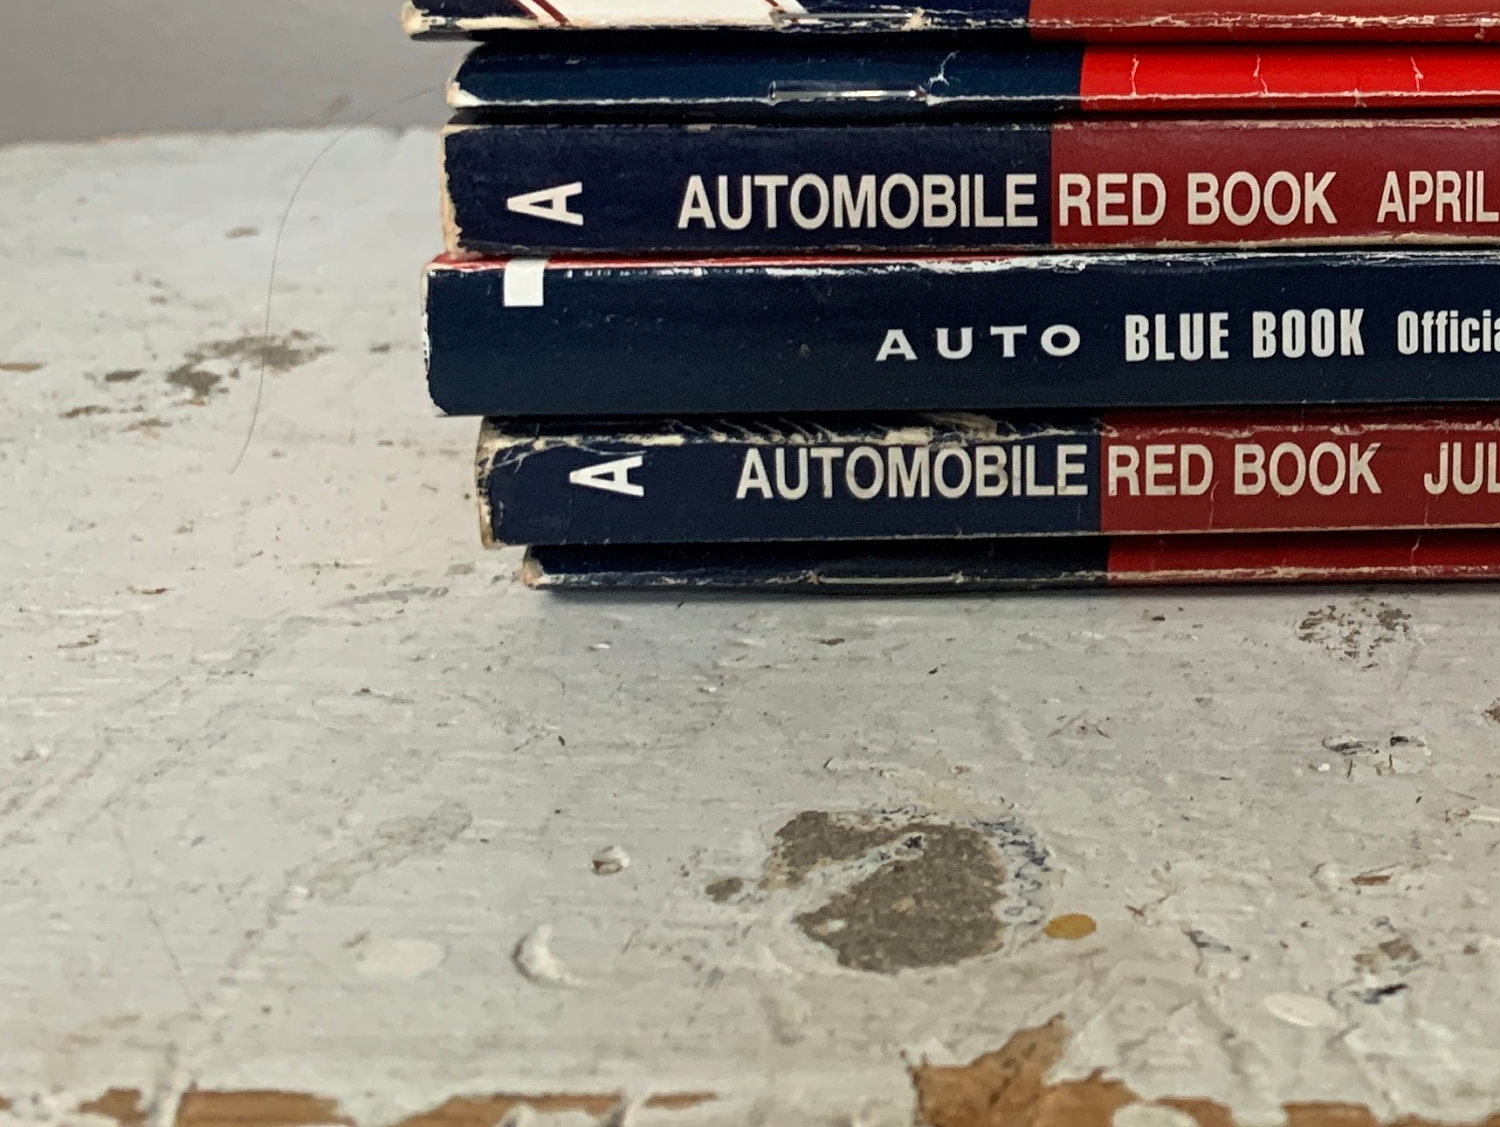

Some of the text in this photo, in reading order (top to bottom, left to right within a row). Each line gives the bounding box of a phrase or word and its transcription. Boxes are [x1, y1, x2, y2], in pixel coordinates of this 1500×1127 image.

[506, 180, 584, 227] A
[676, 172, 1039, 231] AUTOMOBILE
[1058, 171, 1168, 227] RED
[1186, 169, 1338, 227] BOOK
[1376, 169, 1500, 224] APRIL
[875, 324, 1082, 362] AUTO
[1124, 311, 1230, 363] BLUE
[1251, 307, 1366, 360] BOOK
[569, 454, 645, 497] A
[735, 444, 1089, 501] AUTOMOBILE
[1107, 443, 1214, 497] RED
[1233, 442, 1383, 496] BOOK
